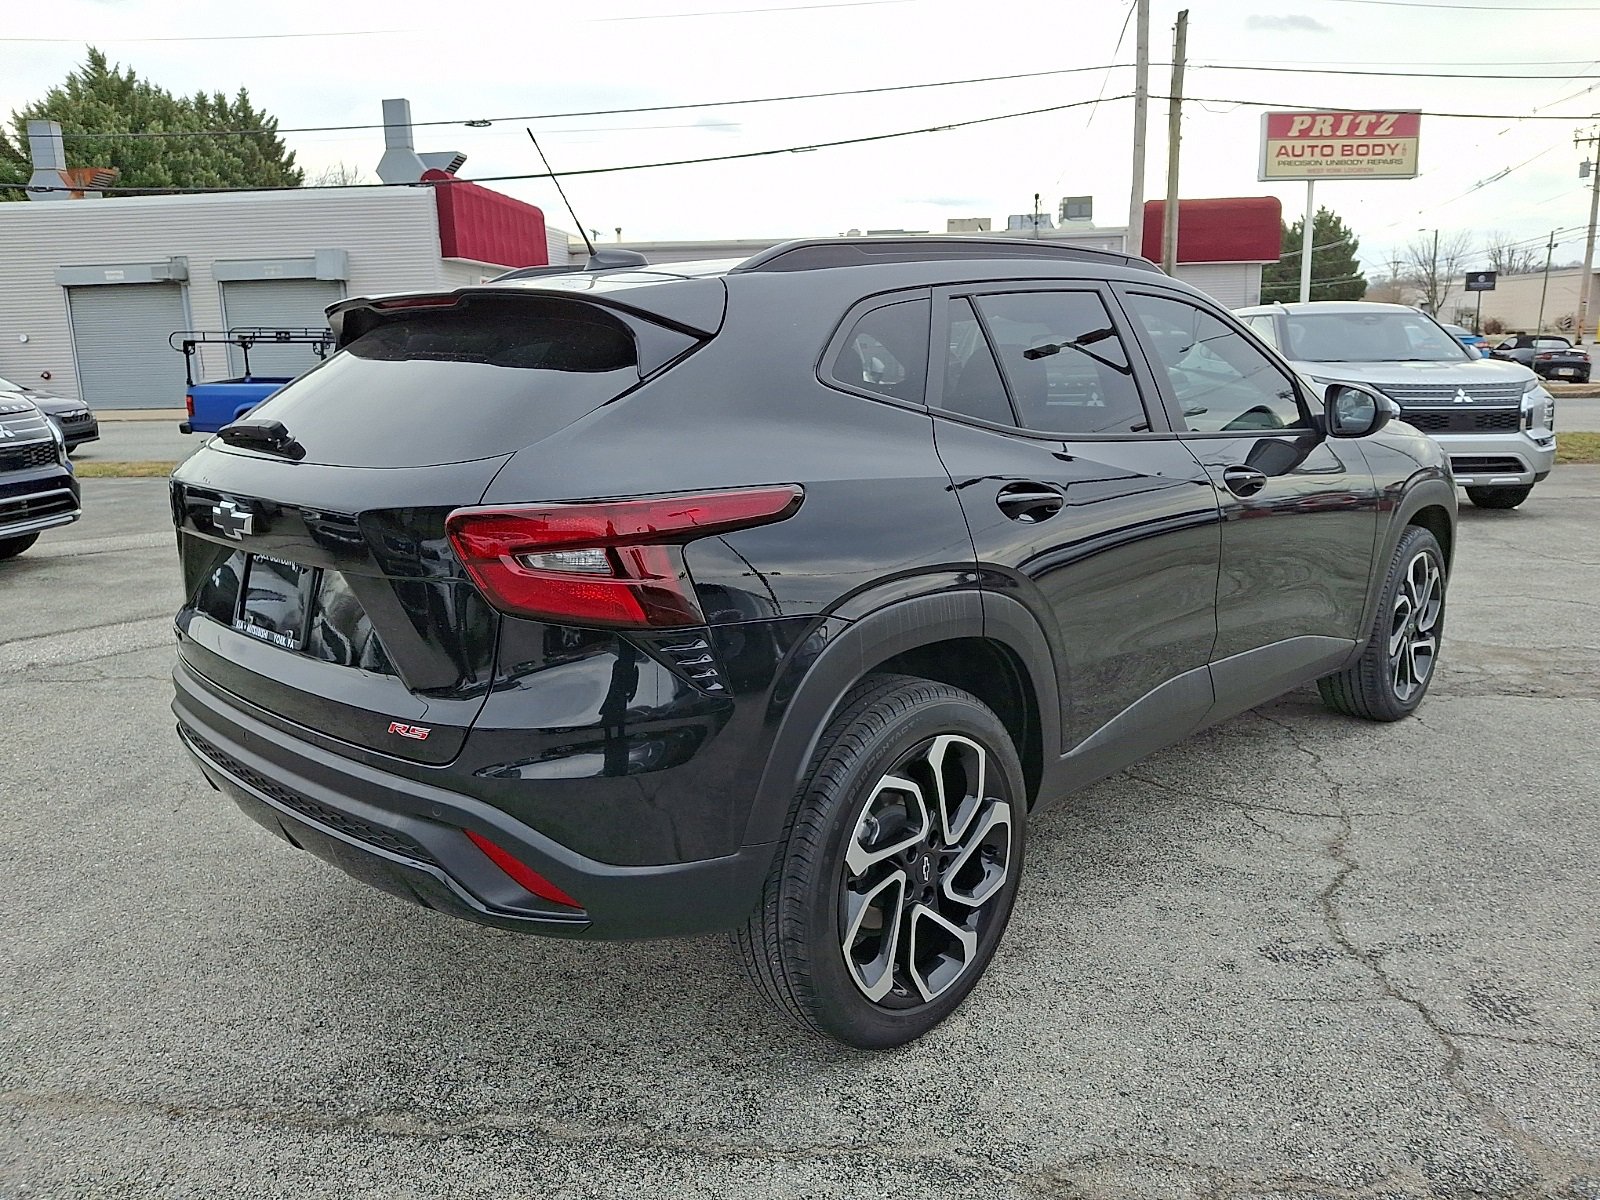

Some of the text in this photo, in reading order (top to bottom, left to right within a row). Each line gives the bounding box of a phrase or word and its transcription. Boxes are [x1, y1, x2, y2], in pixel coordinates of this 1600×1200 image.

[1288, 114, 1399, 137] PRITZ
[1275, 144, 1334, 158] AUTO
[1341, 143, 1399, 157] BODY
[1277, 159, 1322, 167] PRECISION
[388, 721, 431, 740] RS
